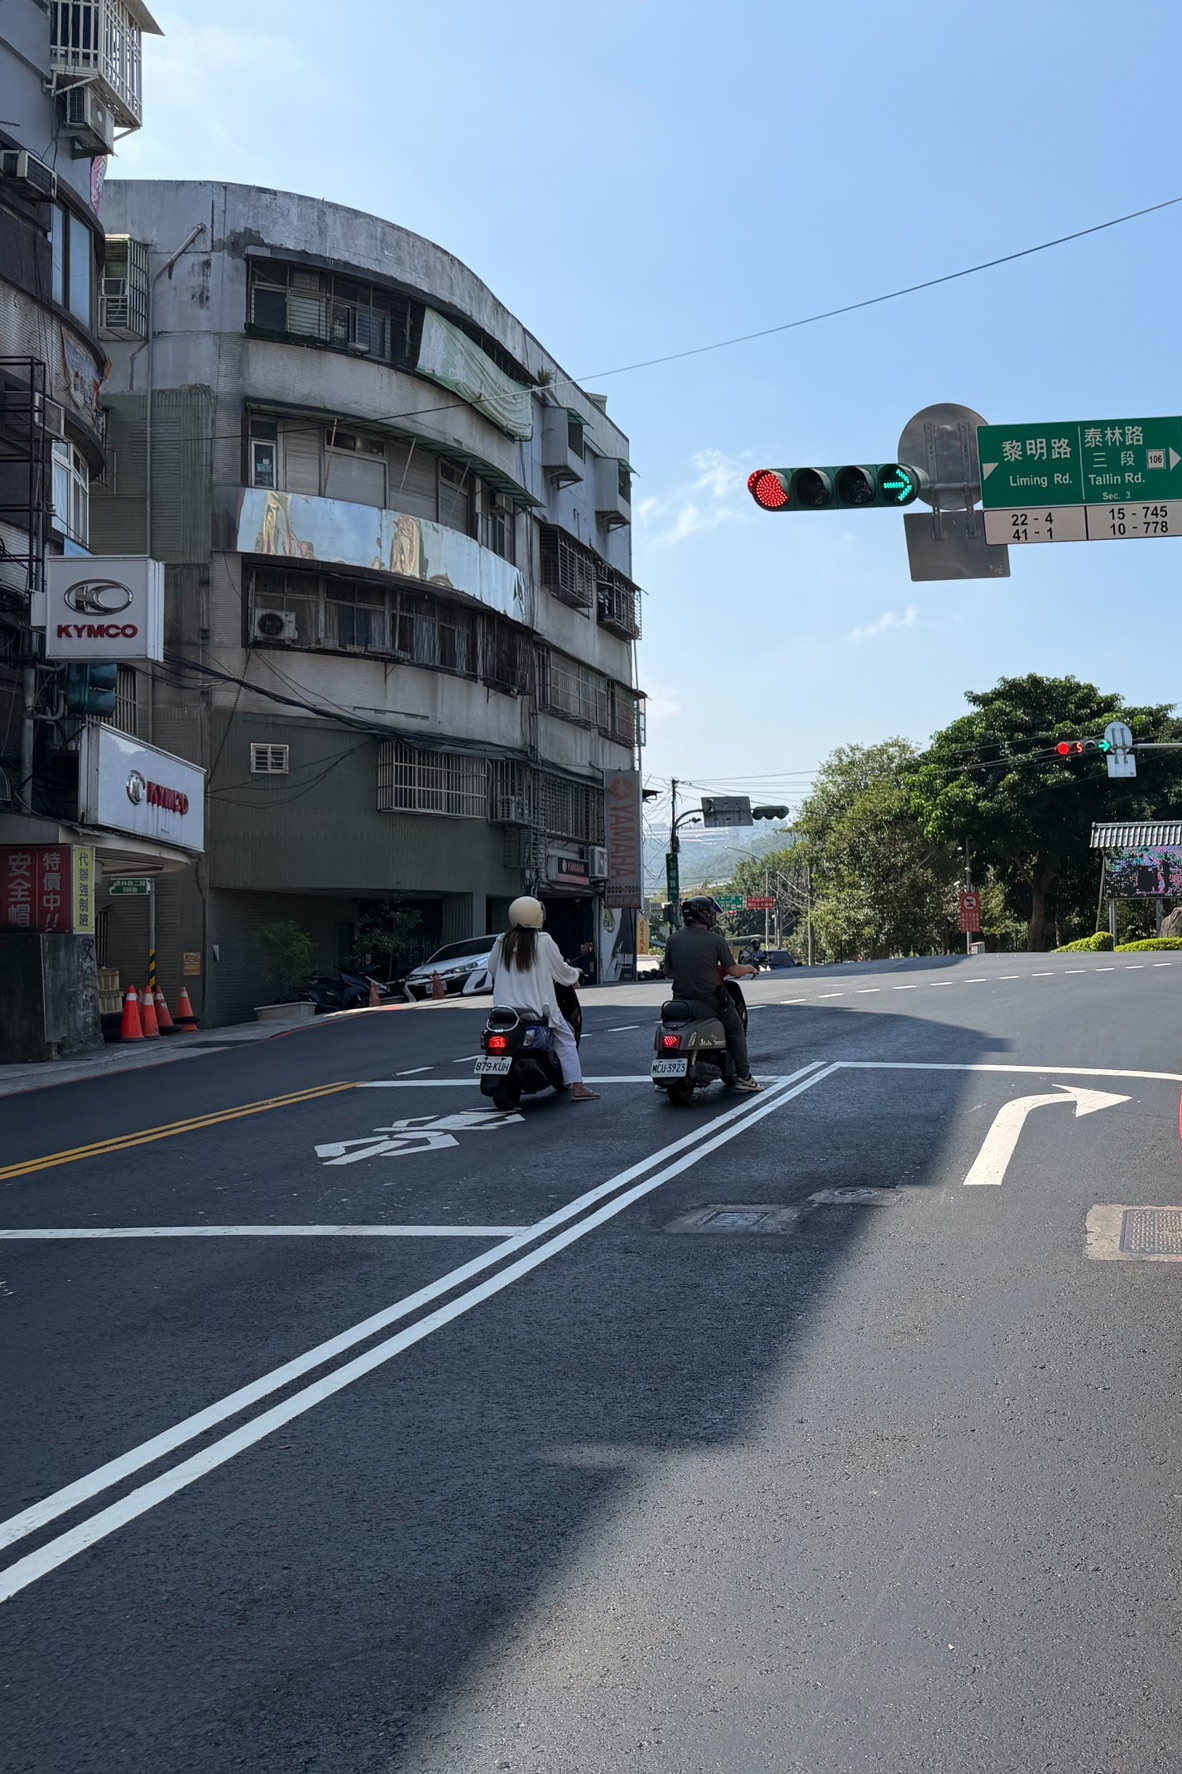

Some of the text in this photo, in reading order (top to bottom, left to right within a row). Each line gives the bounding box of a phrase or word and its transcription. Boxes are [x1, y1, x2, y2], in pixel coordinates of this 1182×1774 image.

[1084, 426, 1144, 448] 泰林路
[1002, 438, 1072, 462] 黎明路
[1093, 451, 1135, 468] 三段
[1149, 455, 1163, 464] 106
[1010, 473, 1073, 488] Liming Rd.
[1088, 472, 1146, 486] Tailin Rd.
[1102, 491, 1131, 500] Sec. 3
[57, 624, 138, 638] KYMCO
[147, 781, 189, 816] KYMCO
[609, 804, 635, 879] YAMAHA
[7, 852, 31, 928] 安全帽
[476, 1062, 509, 1072] 879-KUH
[652, 1063, 686, 1074] MCU-3923
